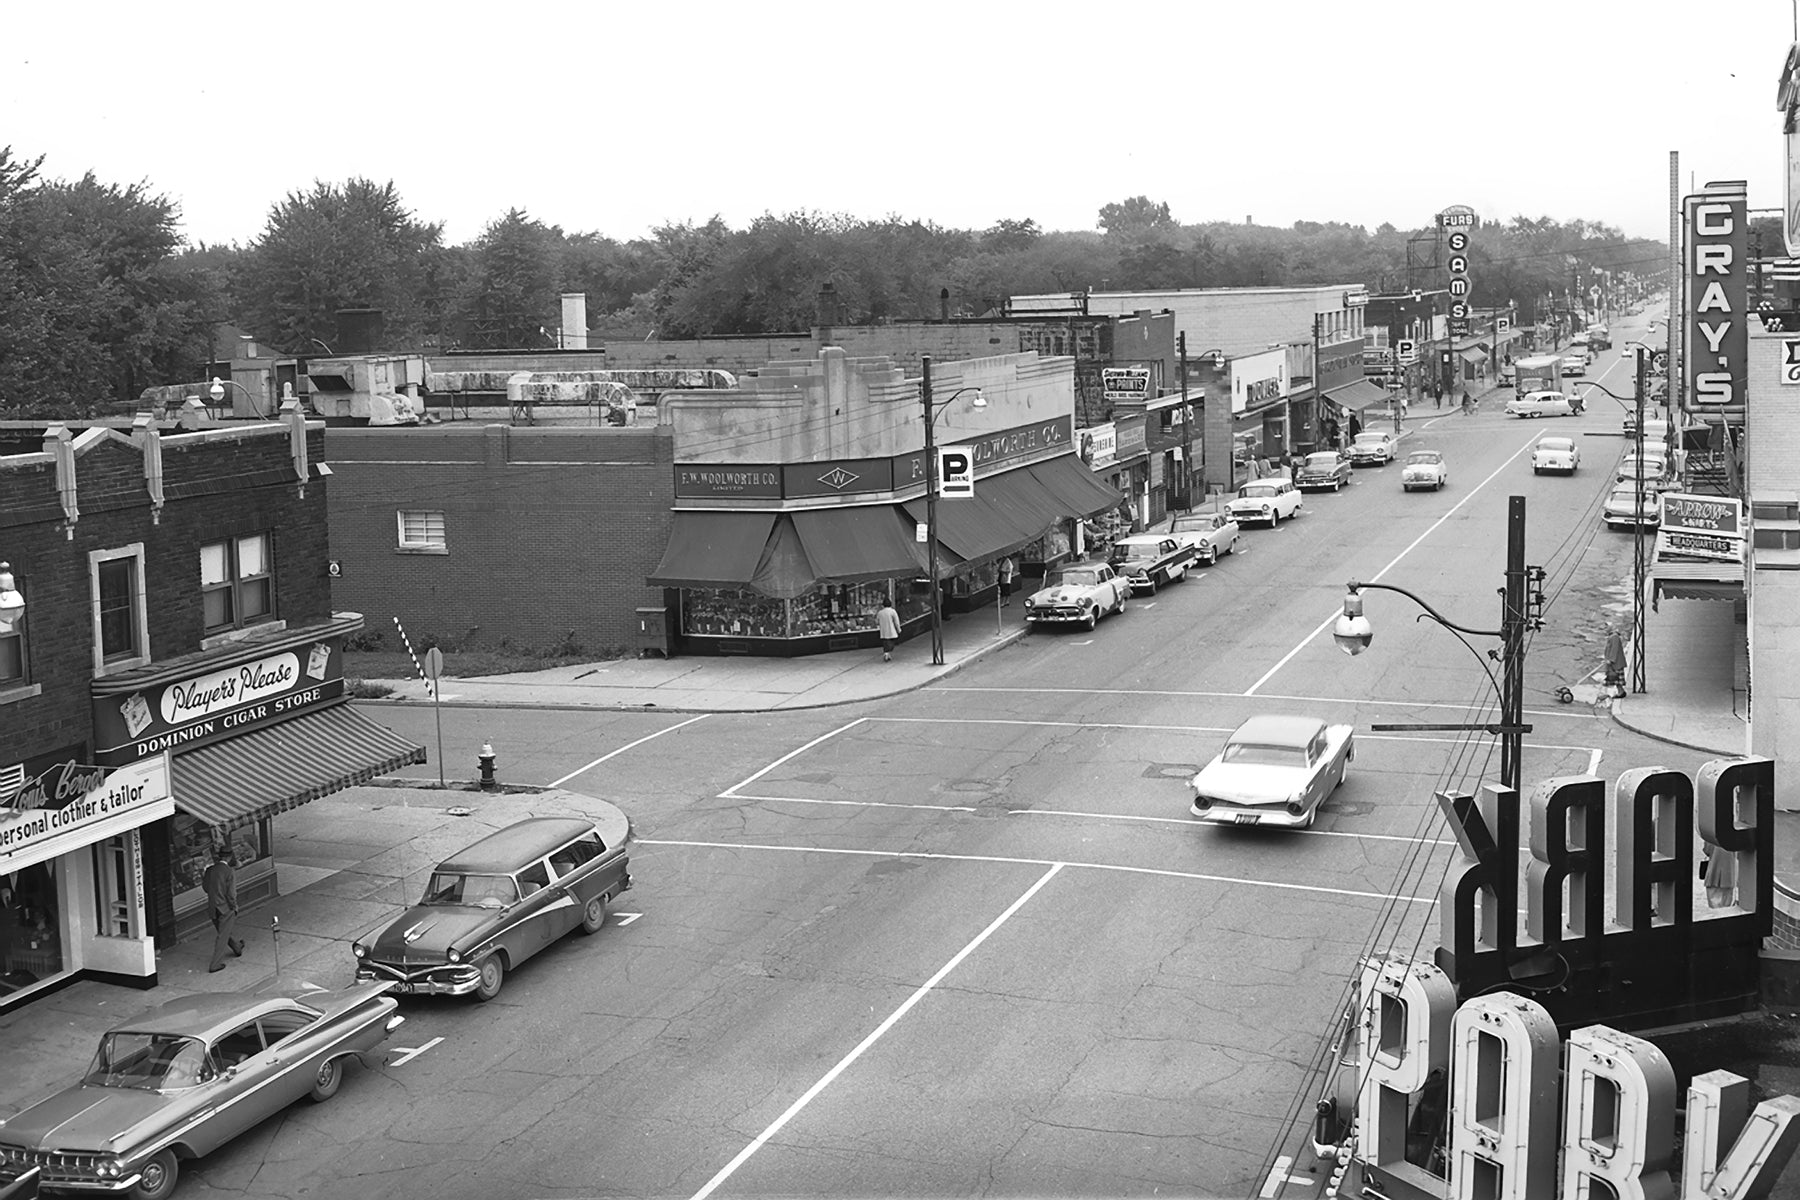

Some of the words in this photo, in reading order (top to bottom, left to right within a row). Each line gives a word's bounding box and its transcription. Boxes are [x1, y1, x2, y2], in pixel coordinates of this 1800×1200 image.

[1443, 215, 1473, 226] FURS
[1696, 203, 1734, 404] GRAY'S
[1117, 379, 1143, 390] PAINTS
[973, 430, 1036, 462] OLWORTH
[1042, 424, 1062, 443] CO.
[762, 473, 778, 485] CO.
[1671, 500, 1727, 519] ARROW
[1681, 517, 1719, 529] SHIRTS
[1672, 536, 1728, 551] HEADQUARTERS
[170, 677, 237, 722] Player's
[238, 663, 293, 702] Please
[137, 721, 214, 757] DOMINION
[223, 705, 267, 728] CIGAR
[275, 688, 321, 712] STORE
[0, 774, 49, 822] Louis
[55, 759, 107, 805] Berger
[51, 799, 97, 829] clothier
[100, 798, 108, 813] &
[1356, 955, 1800, 1200] PARK
